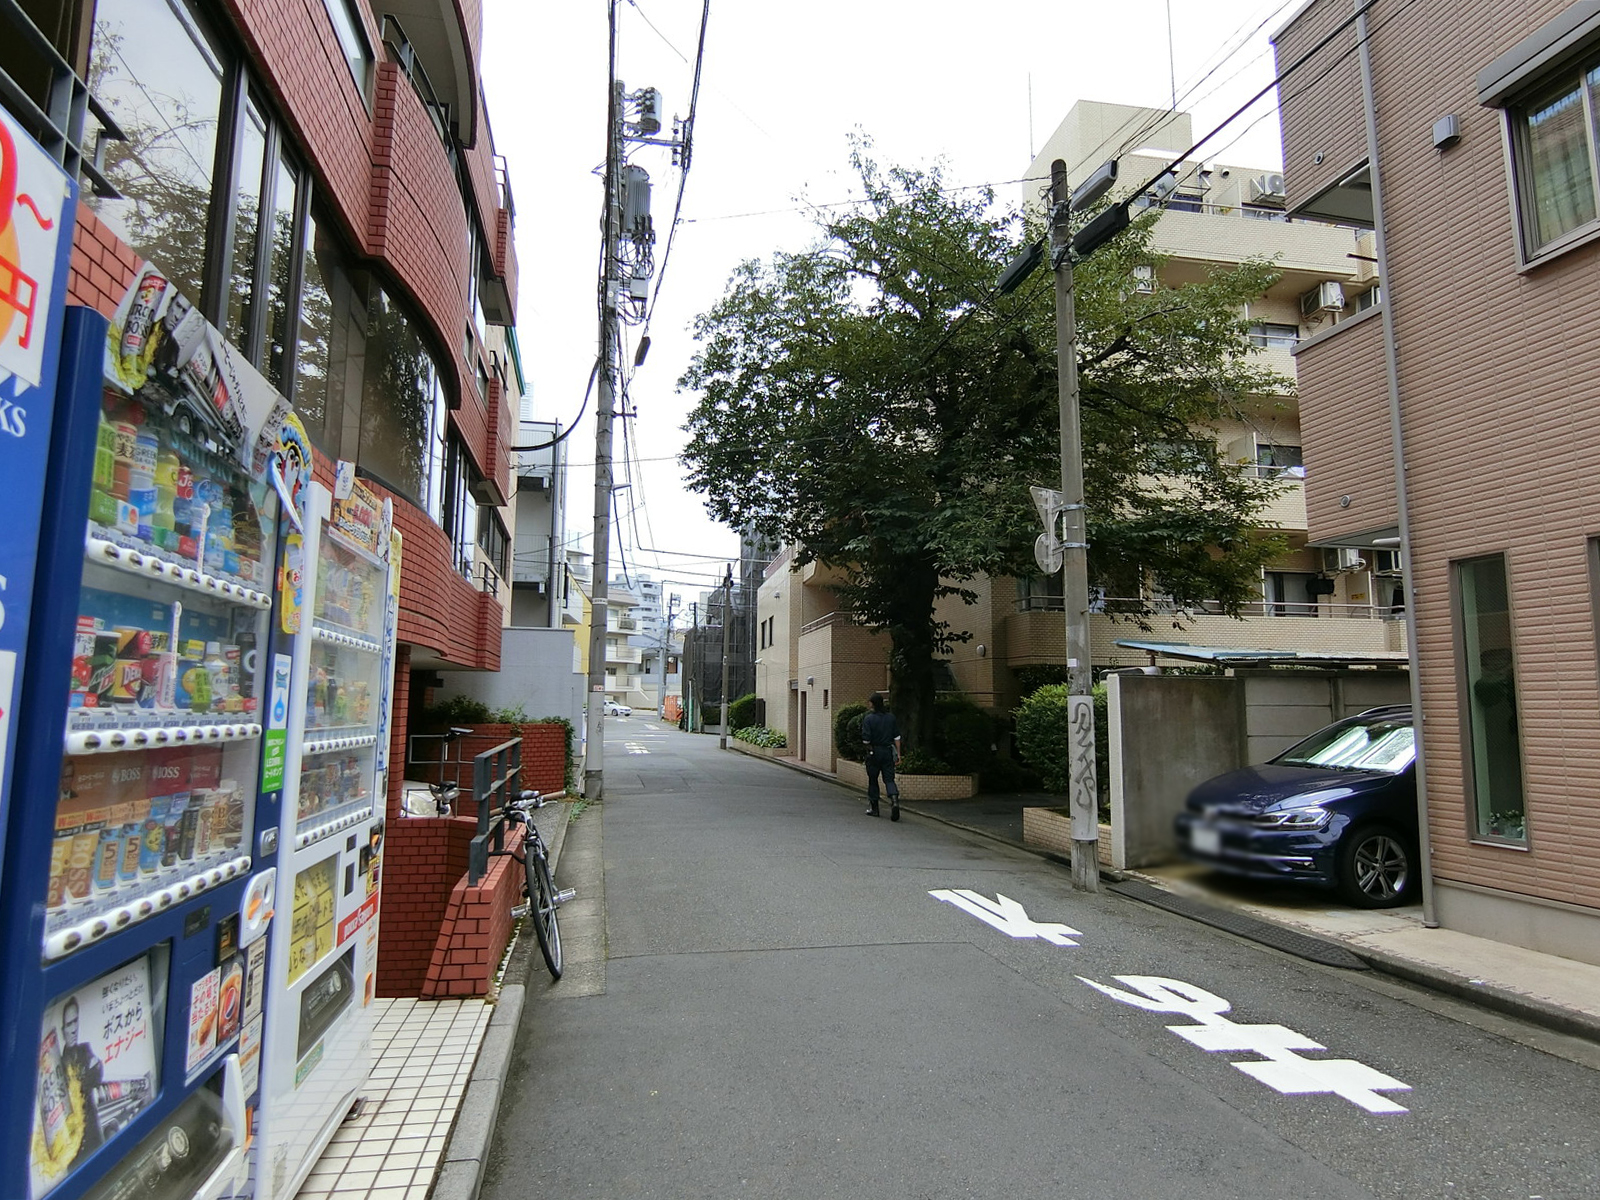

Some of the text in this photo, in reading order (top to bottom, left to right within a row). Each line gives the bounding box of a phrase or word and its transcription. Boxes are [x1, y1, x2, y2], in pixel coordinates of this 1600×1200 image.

[120, 767, 141, 783] BOSS
[103, 1002, 144, 1040] ボスから
